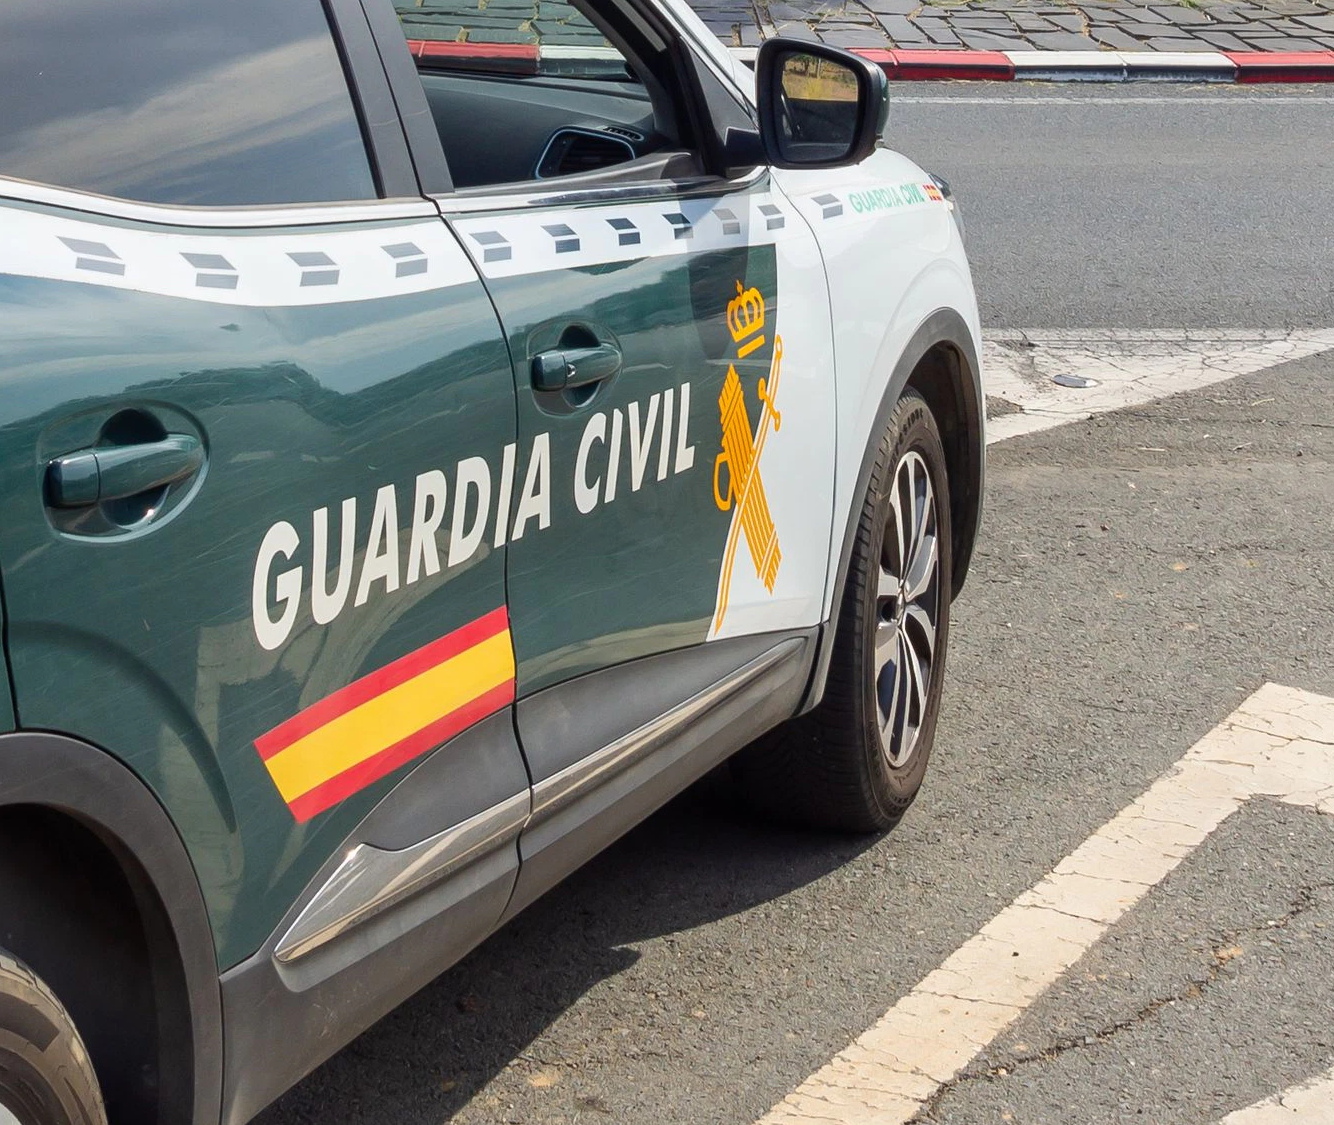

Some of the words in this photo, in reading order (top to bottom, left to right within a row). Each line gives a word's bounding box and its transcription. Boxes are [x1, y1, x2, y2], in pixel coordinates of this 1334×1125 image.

[849, 187, 904, 214] GUARDIA
[899, 183, 925, 205] CIVIL
[251, 431, 552, 651] GUARDIA
[573, 381, 696, 515] CIVIL
